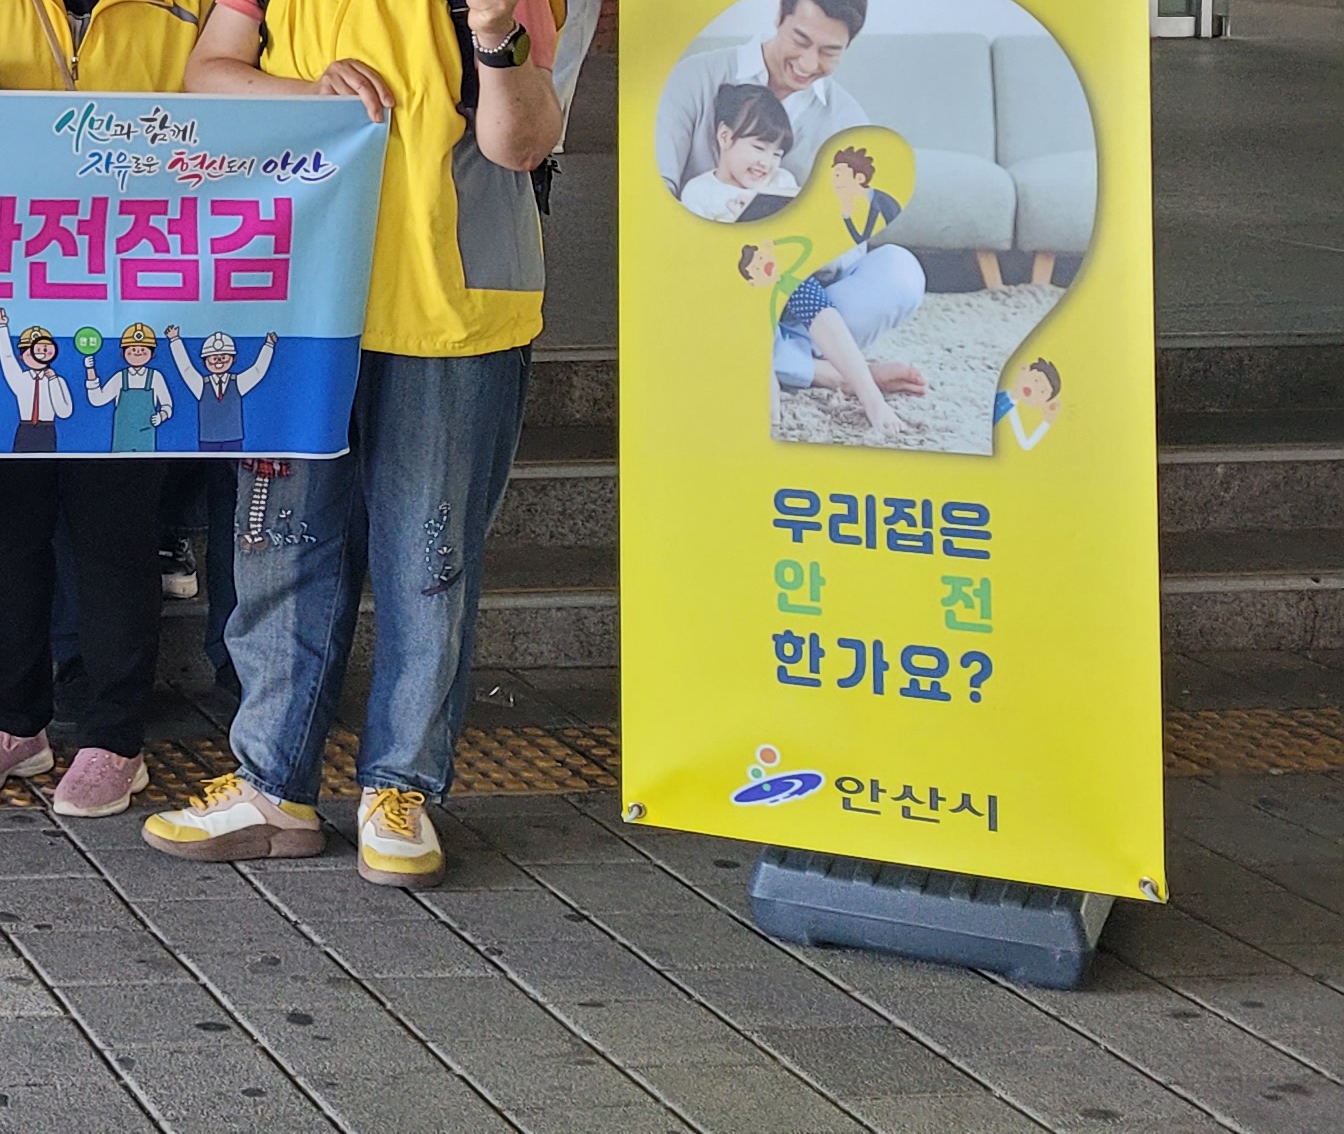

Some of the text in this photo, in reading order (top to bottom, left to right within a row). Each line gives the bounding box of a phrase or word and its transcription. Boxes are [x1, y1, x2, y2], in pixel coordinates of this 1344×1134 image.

[54, 102, 137, 153] 시민과
[78, 150, 338, 191] 자유로운 혁신도시 안산
[772, 488, 993, 561] 우리집은
[774, 559, 993, 632] 안 전
[771, 629, 993, 704] 한가요?
[834, 776, 998, 833] 안산시
